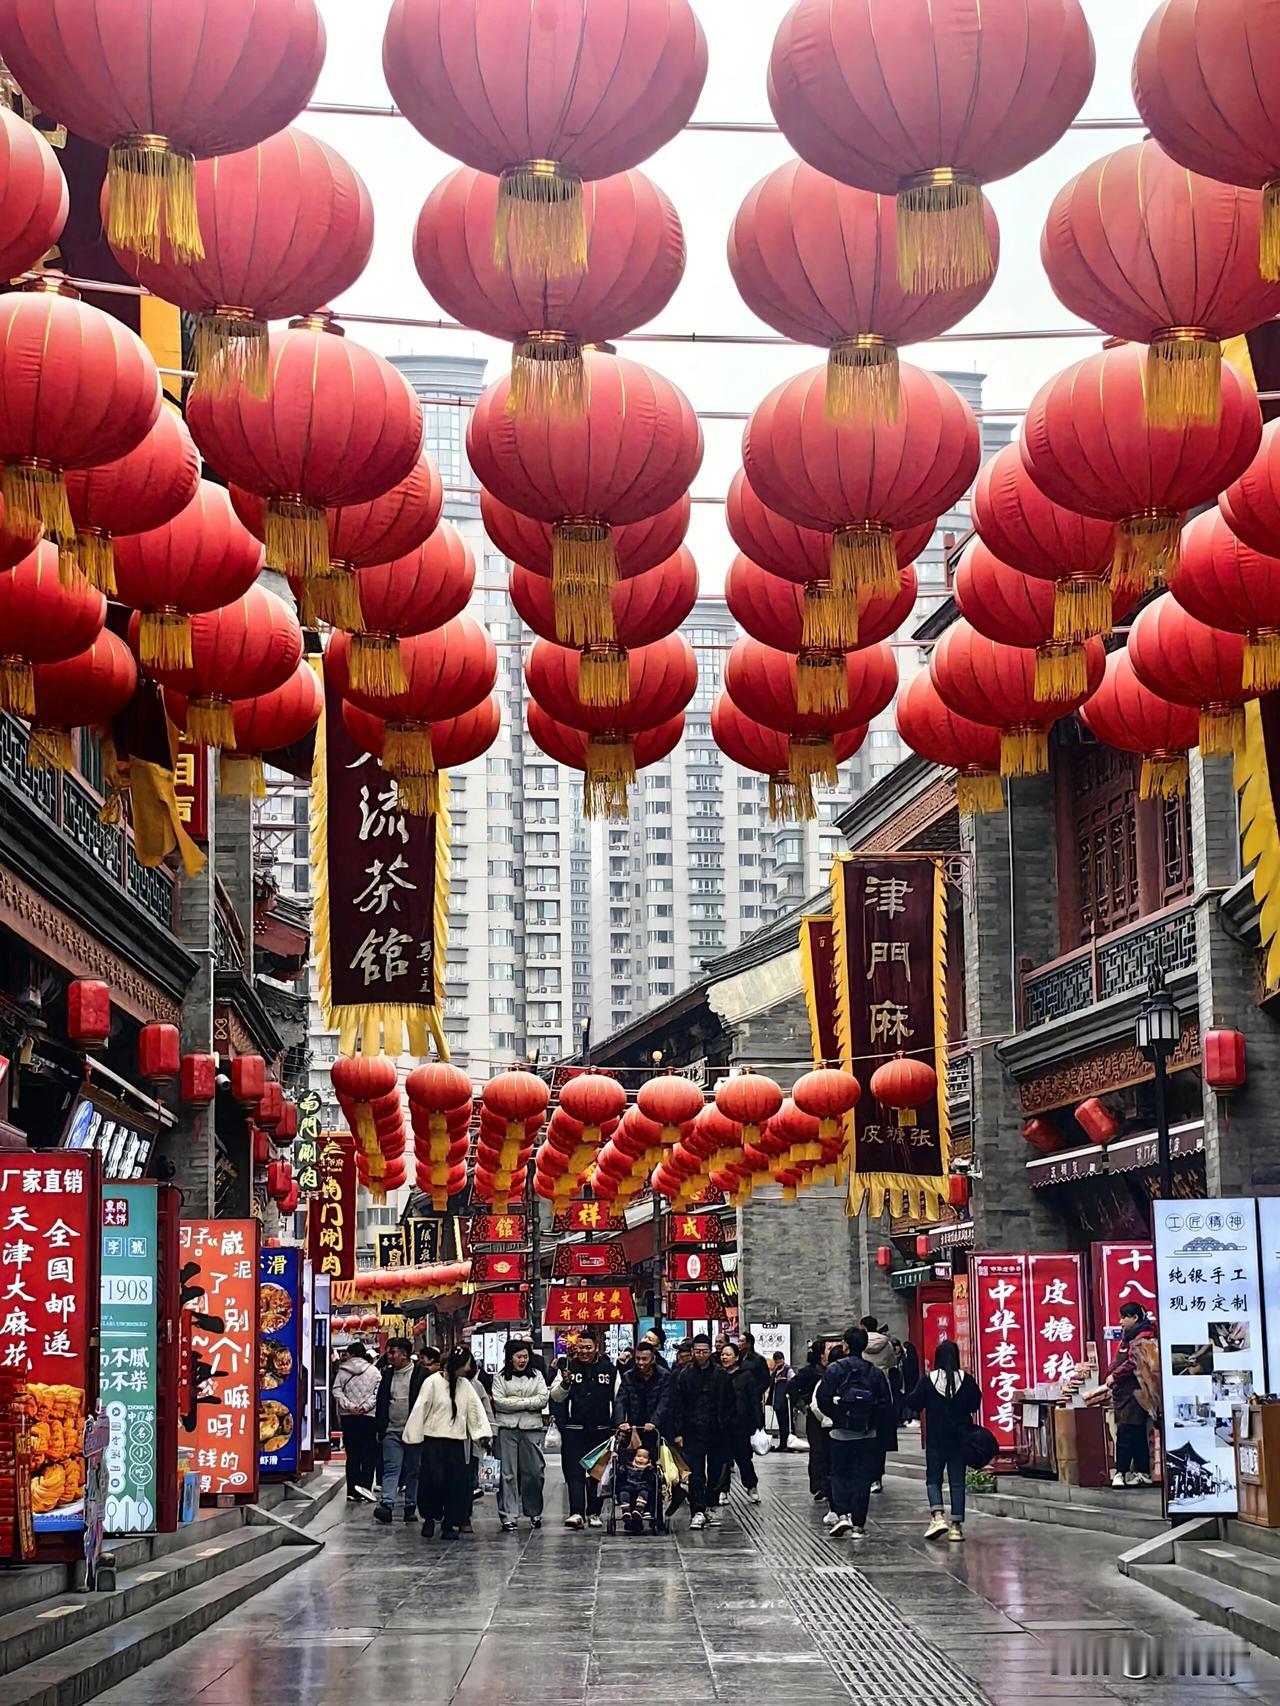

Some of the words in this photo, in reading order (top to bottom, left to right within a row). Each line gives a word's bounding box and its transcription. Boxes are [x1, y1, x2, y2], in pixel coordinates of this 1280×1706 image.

[345, 752, 418, 986] 流茶館
[865, 877, 914, 1110] 津門麻
[1, 1169, 83, 1193] 厂家直销
[579, 1202, 601, 1229] 祥
[1169, 1214, 1242, 1232] 工匠精神
[0, 1206, 38, 1370] 天津大麻花
[43, 1219, 81, 1357] 全国邮递
[560, 1290, 622, 1305] 文明健康
[1117, 1250, 1157, 1322] 十八
[1168, 1267, 1247, 1286] 纯银手工
[1170, 1294, 1247, 1313] 现场定制
[985, 1279, 1020, 1433] 中华老字号
